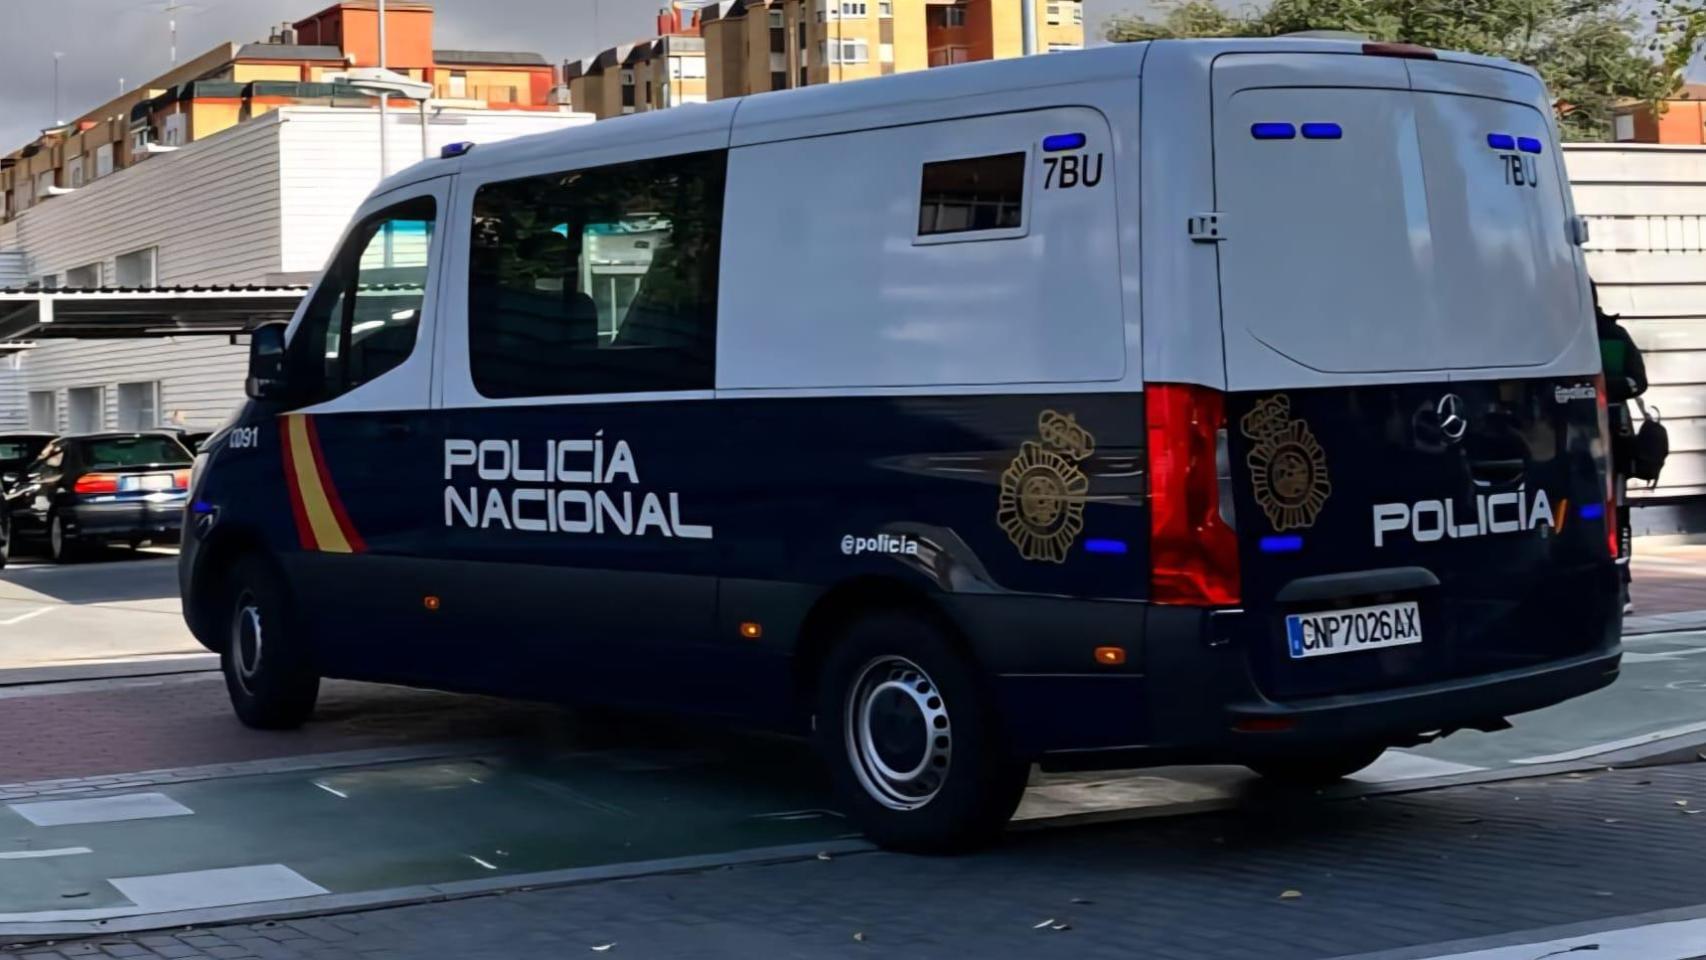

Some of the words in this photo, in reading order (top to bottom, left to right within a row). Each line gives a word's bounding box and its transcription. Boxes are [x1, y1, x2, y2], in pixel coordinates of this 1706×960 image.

[1043, 153, 1103, 190] 7BU
[1499, 154, 1537, 188] 7BU
[444, 429, 639, 484] POLICÍA
[444, 485, 713, 539] NACIONAL
[1373, 483, 1556, 547] POLICÍA
[840, 534, 918, 555] @policia
